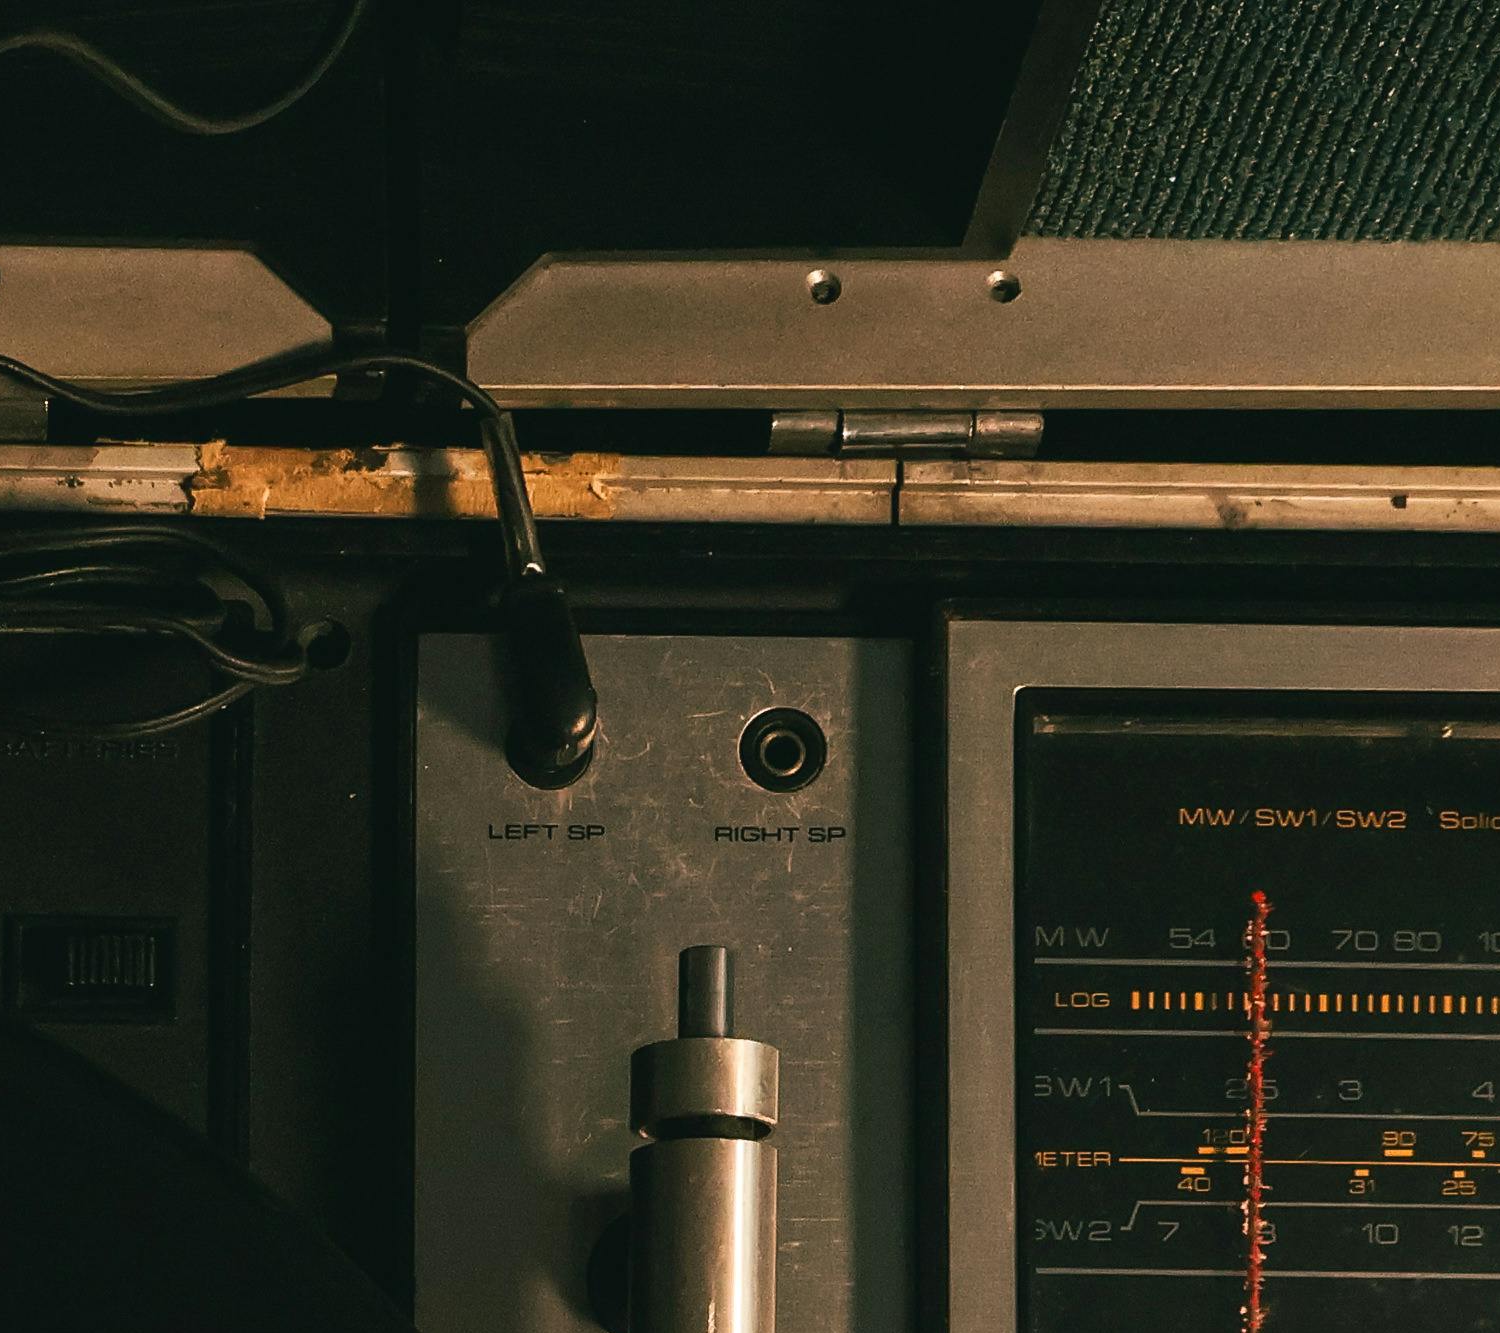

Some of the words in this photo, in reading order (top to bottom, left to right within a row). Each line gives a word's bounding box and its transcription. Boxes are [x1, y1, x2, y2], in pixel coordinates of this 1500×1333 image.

[1178, 807, 1408, 829] MW/SW1/SW2
[488, 824, 559, 841] LEFT
[567, 824, 606, 841] SP
[714, 826, 800, 843] RIGHT
[807, 827, 847, 843] SP
[1168, 928, 1217, 950] 54
[1330, 930, 1379, 951] 70
[1393, 930, 1442, 952] 80
[1055, 992, 1111, 1008] LOG
[1338, 1079, 1364, 1101] 3
[1472, 1081, 1496, 1102] 4
[1382, 1131, 1417, 1147] 90
[1461, 1132, 1495, 1148] 75
[1177, 1177, 1211, 1192] 40
[1349, 1179, 1376, 1194] 31
[1441, 1181, 1477, 1196] 25
[1158, 1222, 1180, 1242] 7
[1361, 1223, 1400, 1245] 10
[1448, 1225, 1485, 1247] 12
